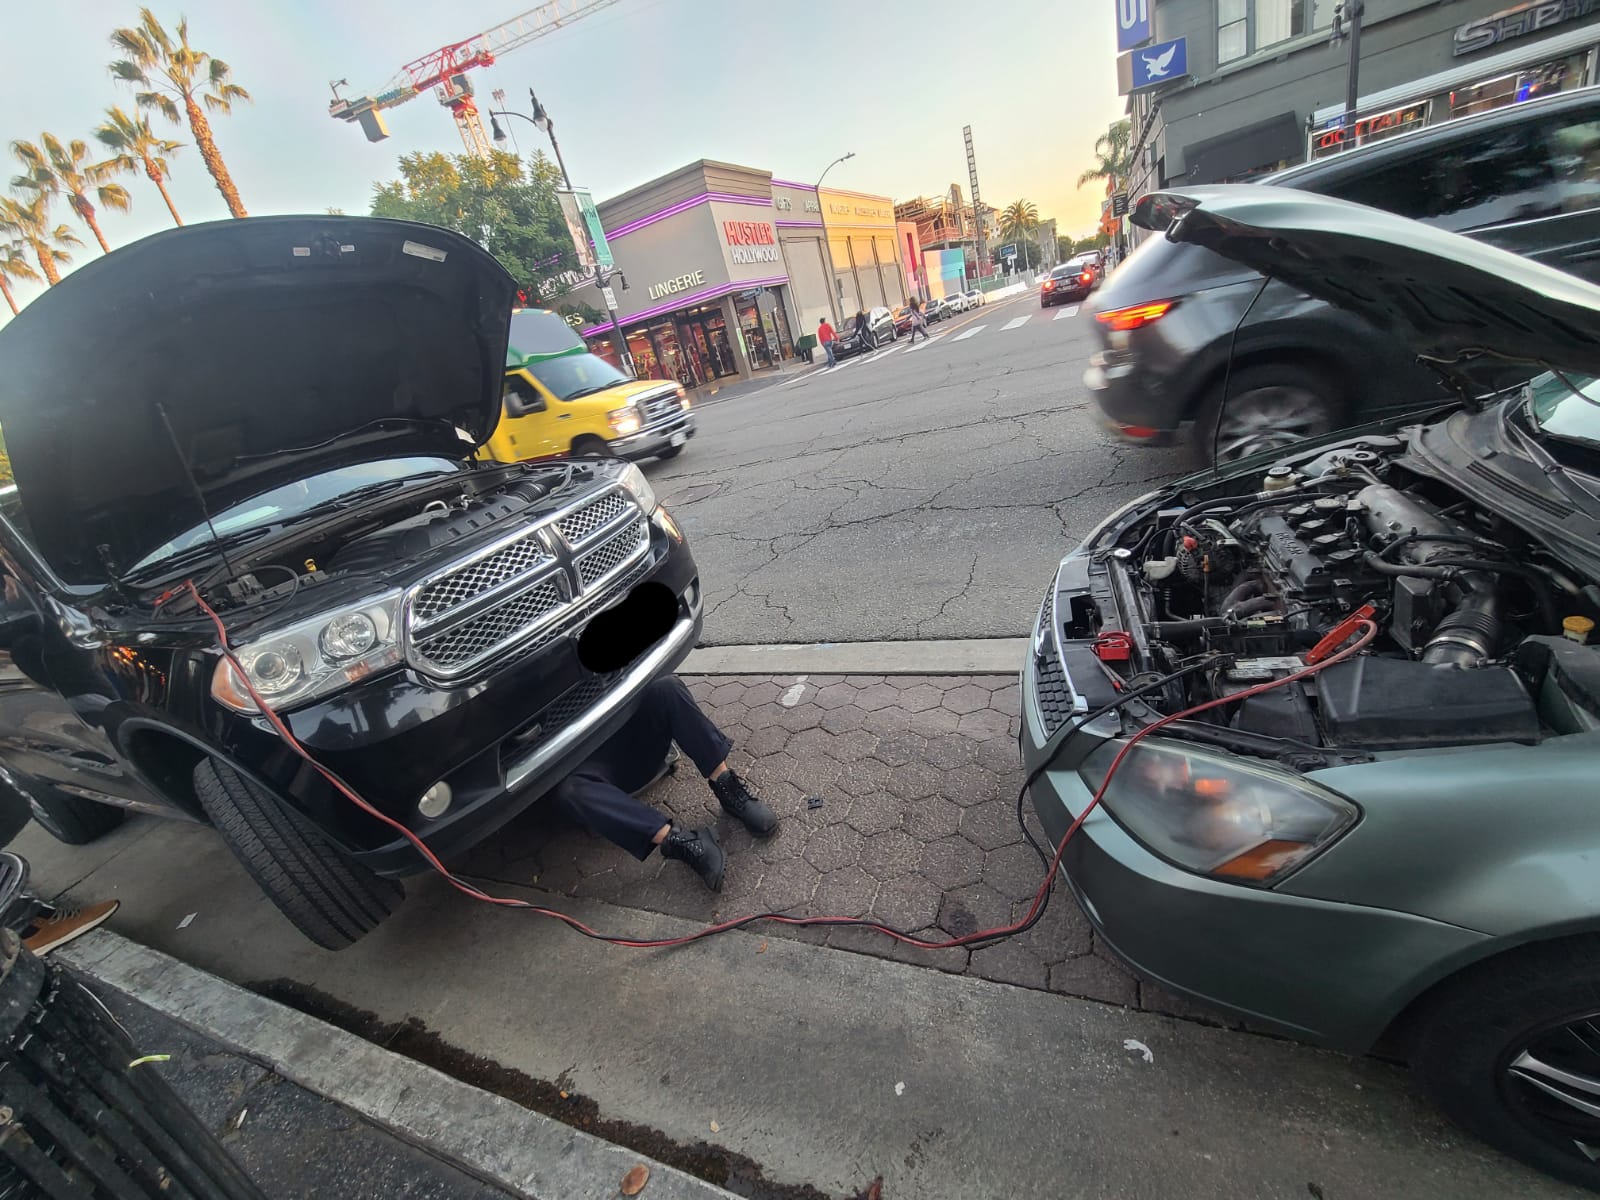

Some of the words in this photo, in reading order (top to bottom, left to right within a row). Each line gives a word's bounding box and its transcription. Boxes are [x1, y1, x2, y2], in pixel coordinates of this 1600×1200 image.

[723, 221, 775, 246] HUSTLER
[731, 247, 778, 264] HOLLYWOOD
[648, 269, 706, 300] LINGERIE
